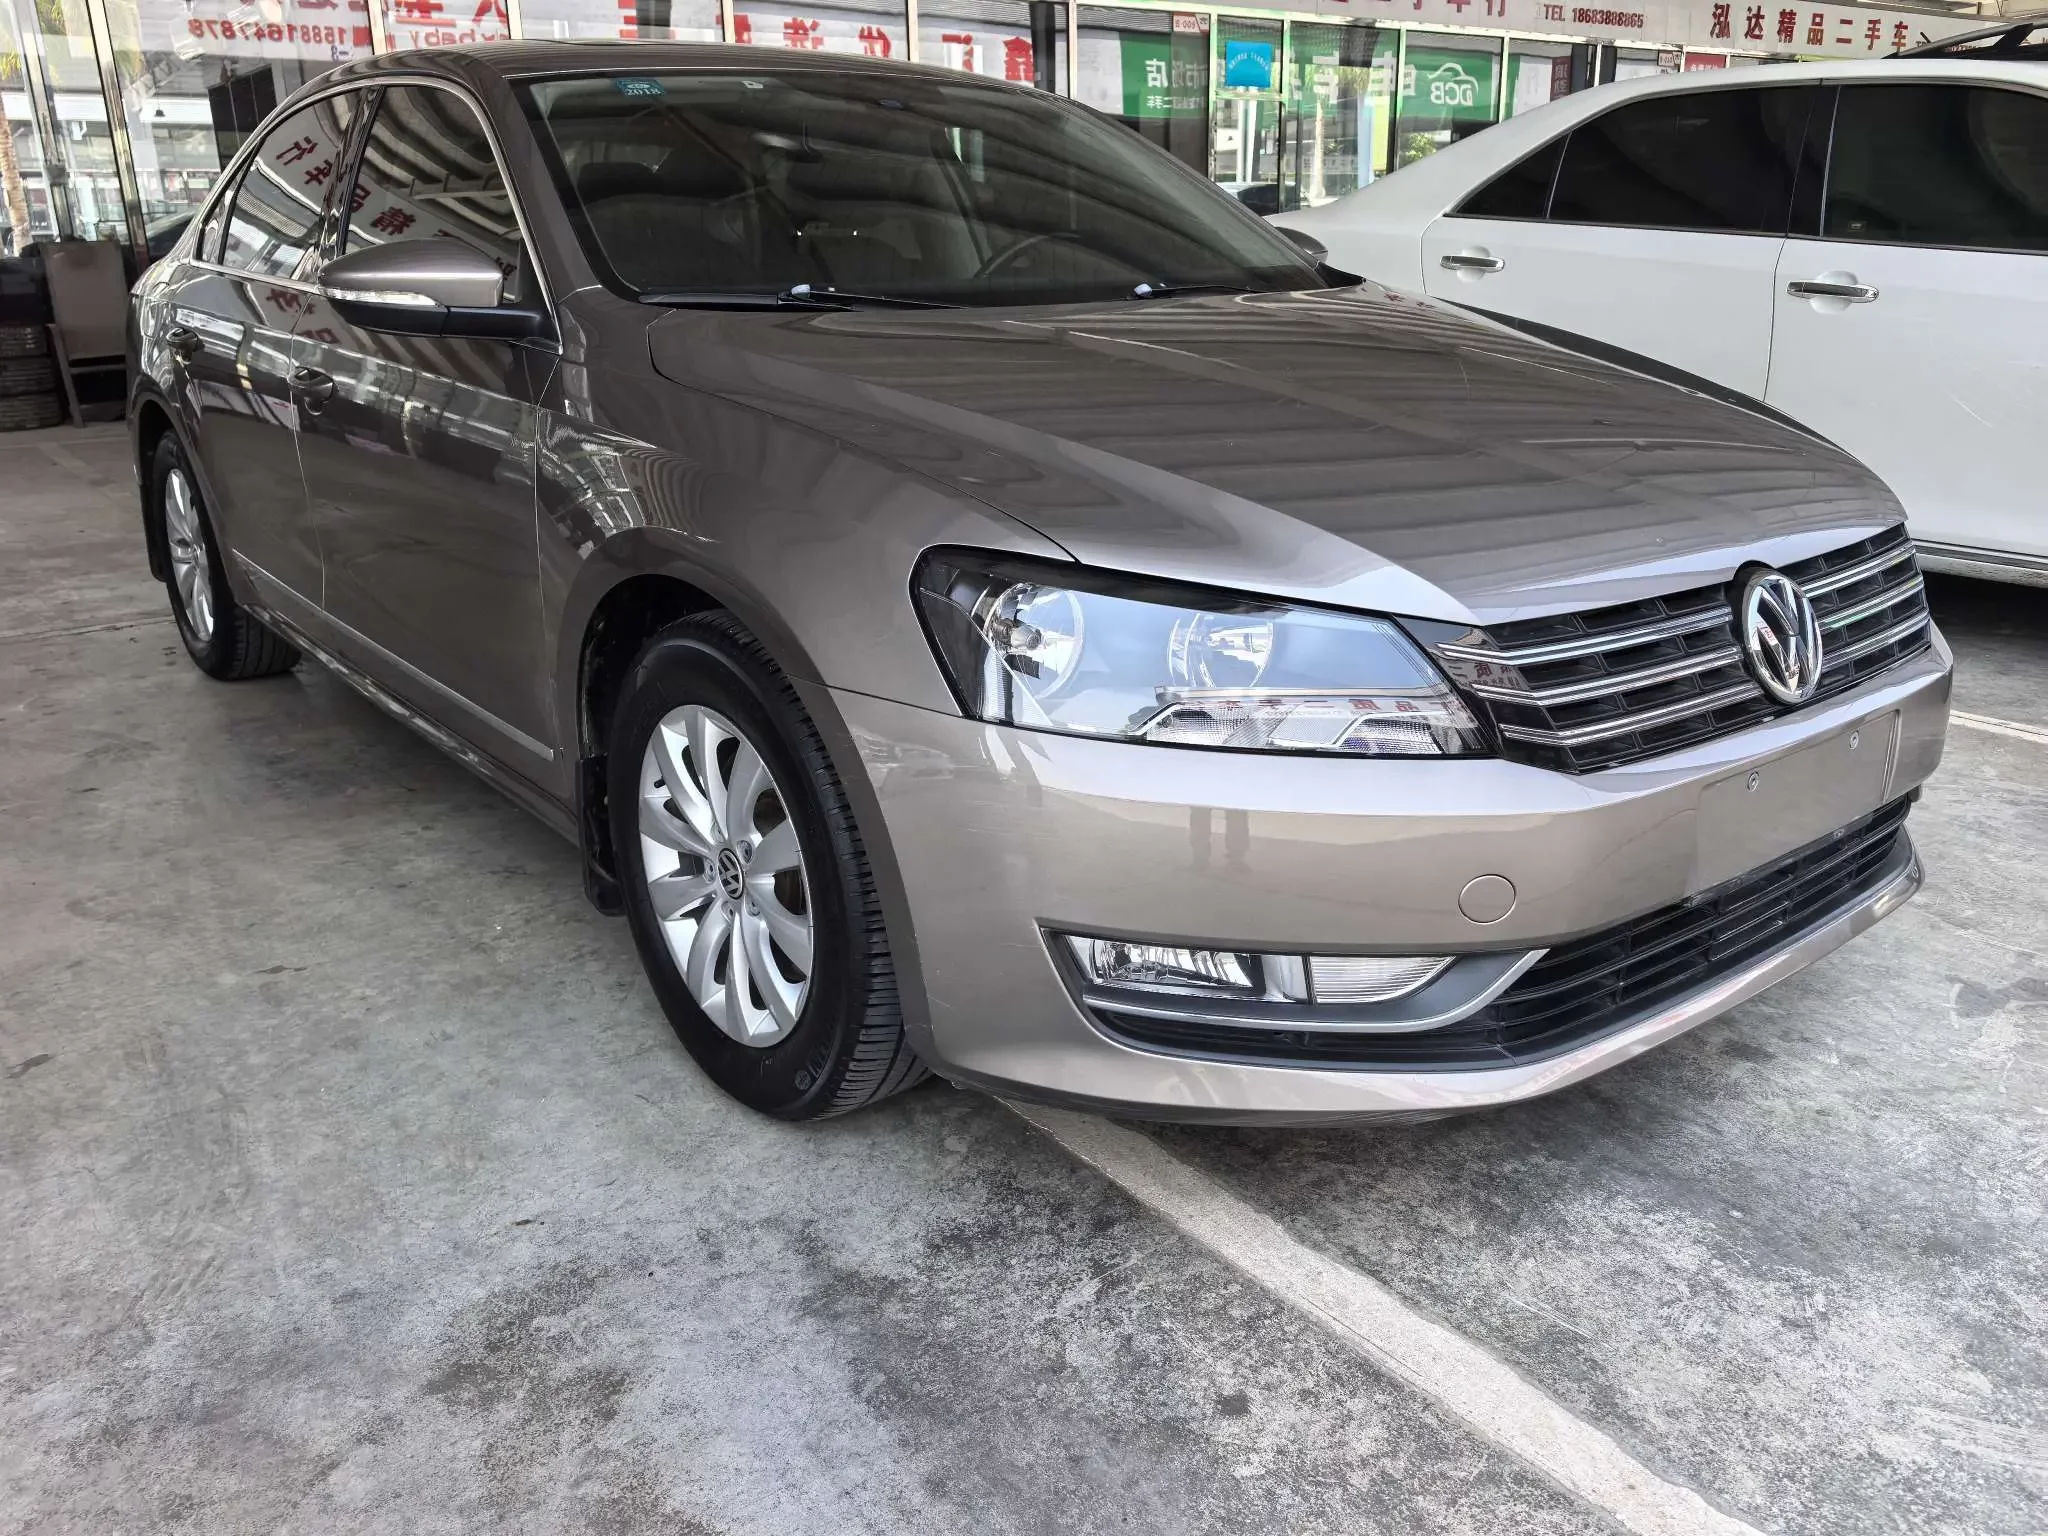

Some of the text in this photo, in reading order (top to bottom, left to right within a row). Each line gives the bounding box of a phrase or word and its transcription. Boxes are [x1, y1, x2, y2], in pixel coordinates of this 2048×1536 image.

[1543, 4, 1566, 22] TEL
[1709, 2, 1909, 53] 泓达精品二手车
